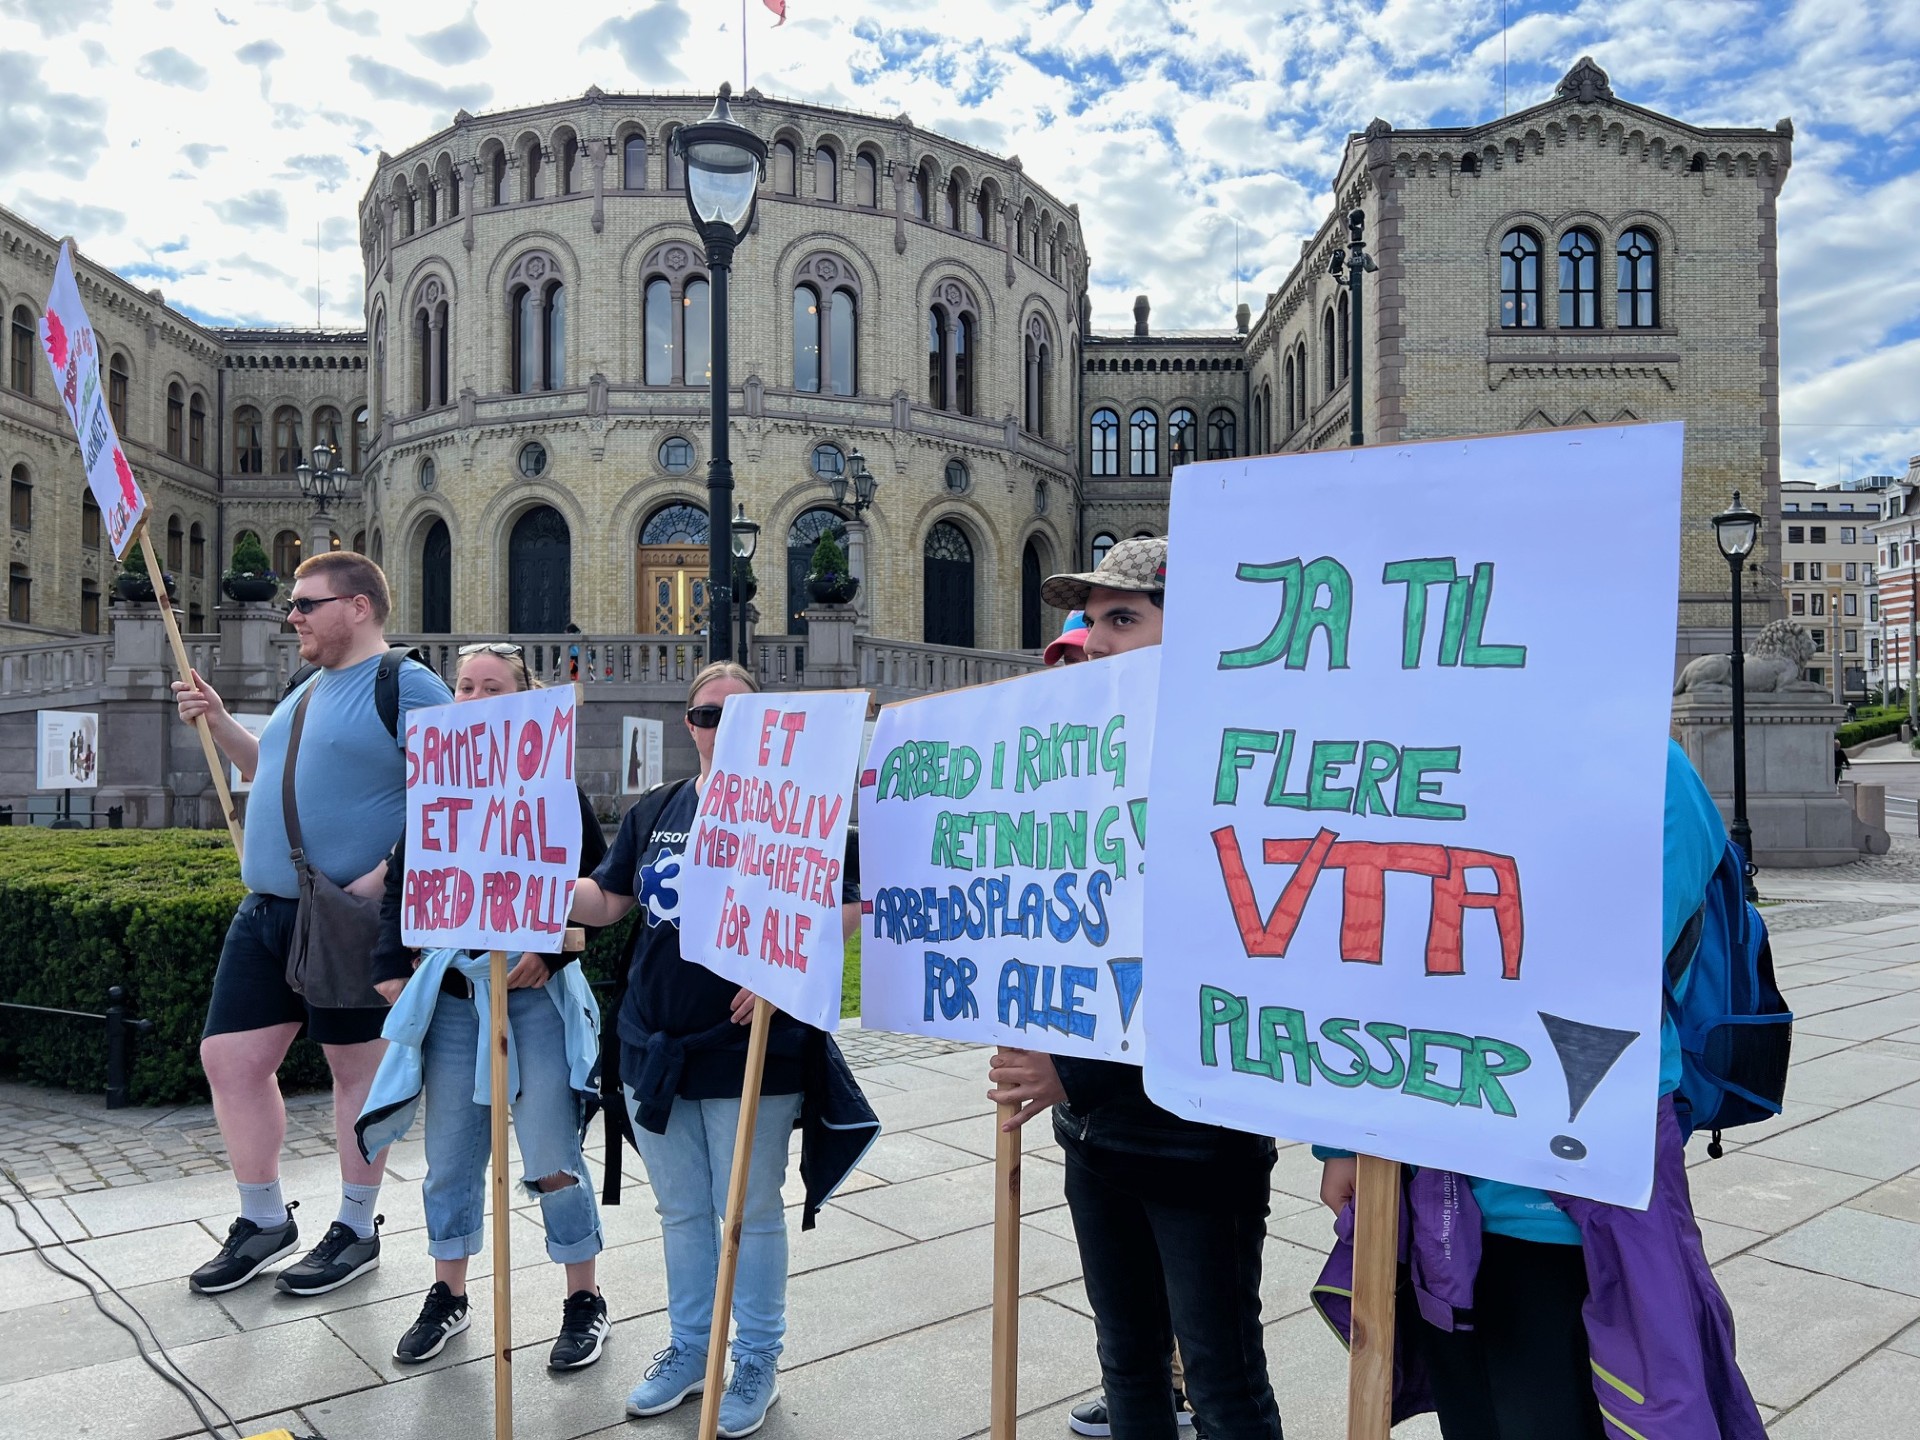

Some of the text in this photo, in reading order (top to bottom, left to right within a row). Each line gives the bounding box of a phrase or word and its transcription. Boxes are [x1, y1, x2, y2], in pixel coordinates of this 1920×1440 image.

[1217, 556, 1527, 670] JA TIL
[406, 722, 511, 790] SAMMEN
[517, 704, 574, 782] OM
[758, 709, 806, 767] ET
[990, 740, 1005, 789] I
[1014, 714, 1127, 793] RIKTIG
[1213, 728, 1466, 820] FLERE
[422, 785, 567, 864] ET MÅL
[700, 769, 843, 840] ARBEIDSLIV
[405, 866, 475, 932] ARBEID
[479, 871, 521, 933] FOR
[694, 819, 840, 909] MED MULIGHETER
[1211, 826, 1525, 980] VTA
[716, 886, 812, 974] FOR ALLE
[923, 951, 979, 1022] FOR
